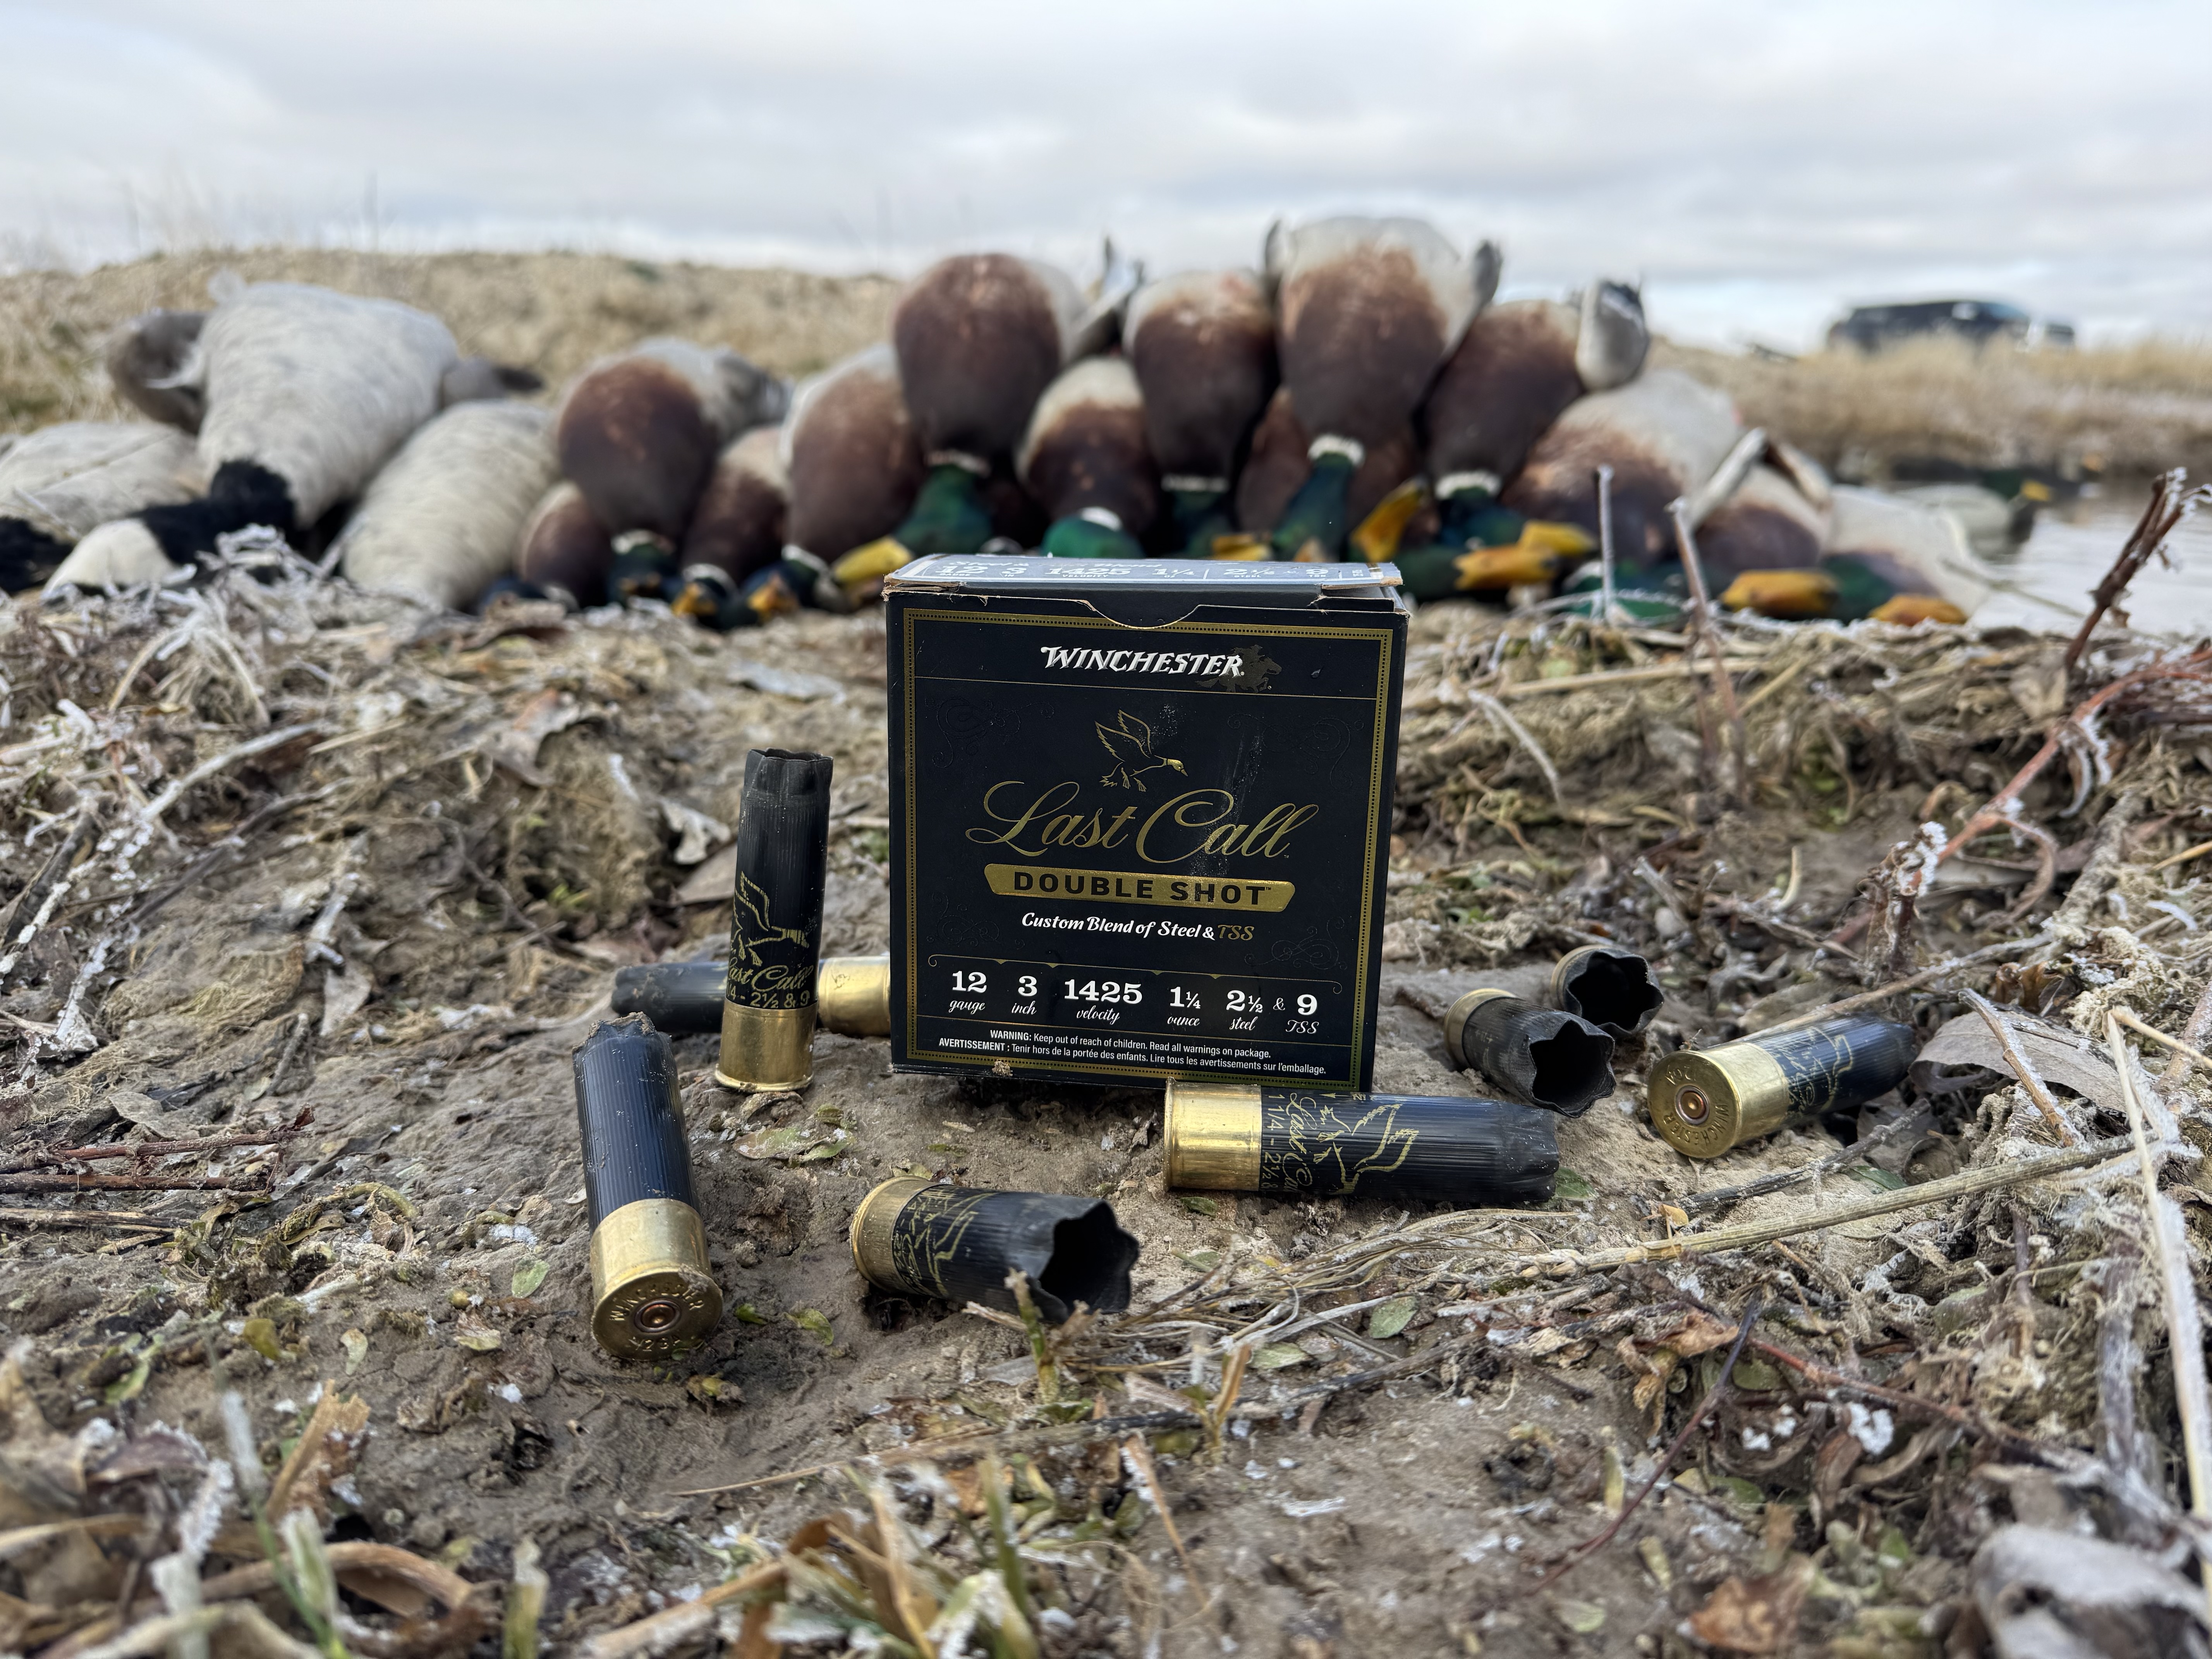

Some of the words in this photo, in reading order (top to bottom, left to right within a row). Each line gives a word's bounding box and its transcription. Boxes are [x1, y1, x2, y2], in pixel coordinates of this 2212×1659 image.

[1041, 646, 1244, 677] WINCHESTER
[966, 781, 1138, 856] Last
[1137, 789, 1319, 863] Call
[1014, 871, 1154, 899] DOUBLE
[1022, 913, 1084, 929] Custom
[1087, 917, 1134, 933] Blend
[1136, 922, 1156, 938] of
[1158, 921, 1201, 937] Steel
[1202, 927, 1215, 940] &
[1218, 925, 1254, 940] TSS
[800, 990, 810, 1006] 9
[953, 971, 986, 993] 12
[1018, 976, 1037, 996] 3
[1065, 979, 1142, 1004] 1425
[1273, 998, 1285, 1010] &
[1297, 994, 1317, 1015] 9
[949, 1001, 985, 1014] gauge
[1012, 1001, 1037, 1015] inch
[1077, 1005, 1120, 1025] velocity
[1167, 1016, 1200, 1026] ounce
[1230, 1017, 1258, 1030] steel
[1286, 1020, 1319, 1034] TSS
[939, 1038, 1005, 1051] AVERTISSEMENT
[1012, 1044, 1030, 1053] Tenir
[1033, 1045, 1049, 1054] hors
[1052, 1047, 1061, 1055] de
[1073, 1049, 1098, 1058] portée
[1101, 1050, 1114, 1059] des
[1117, 1052, 1148, 1061] enfants.
[1151, 1054, 1165, 1062] Lire
[1167, 1056, 1184, 1064] tous
[1187, 1056, 1197, 1065] les
[1200, 1059, 1261, 1069] avertissements
[1278, 1063, 1326, 1075] l'emballage.
[990, 1030, 1031, 1041] WARNING:
[1034, 1033, 1053, 1044] Keep
[1070, 1036, 1078, 1044] of
[1080, 1037, 1101, 1046] reach
[1114, 1039, 1147, 1049] children.
[1150, 1042, 1169, 1051] Read
[1172, 1043, 1181, 1051] all
[1183, 1045, 1220, 1056] warnings
[1235, 1048, 1271, 1059] package.
[1286, 1092, 1318, 1154] Last
[1663, 1104, 1729, 1146] WINCHESTER
